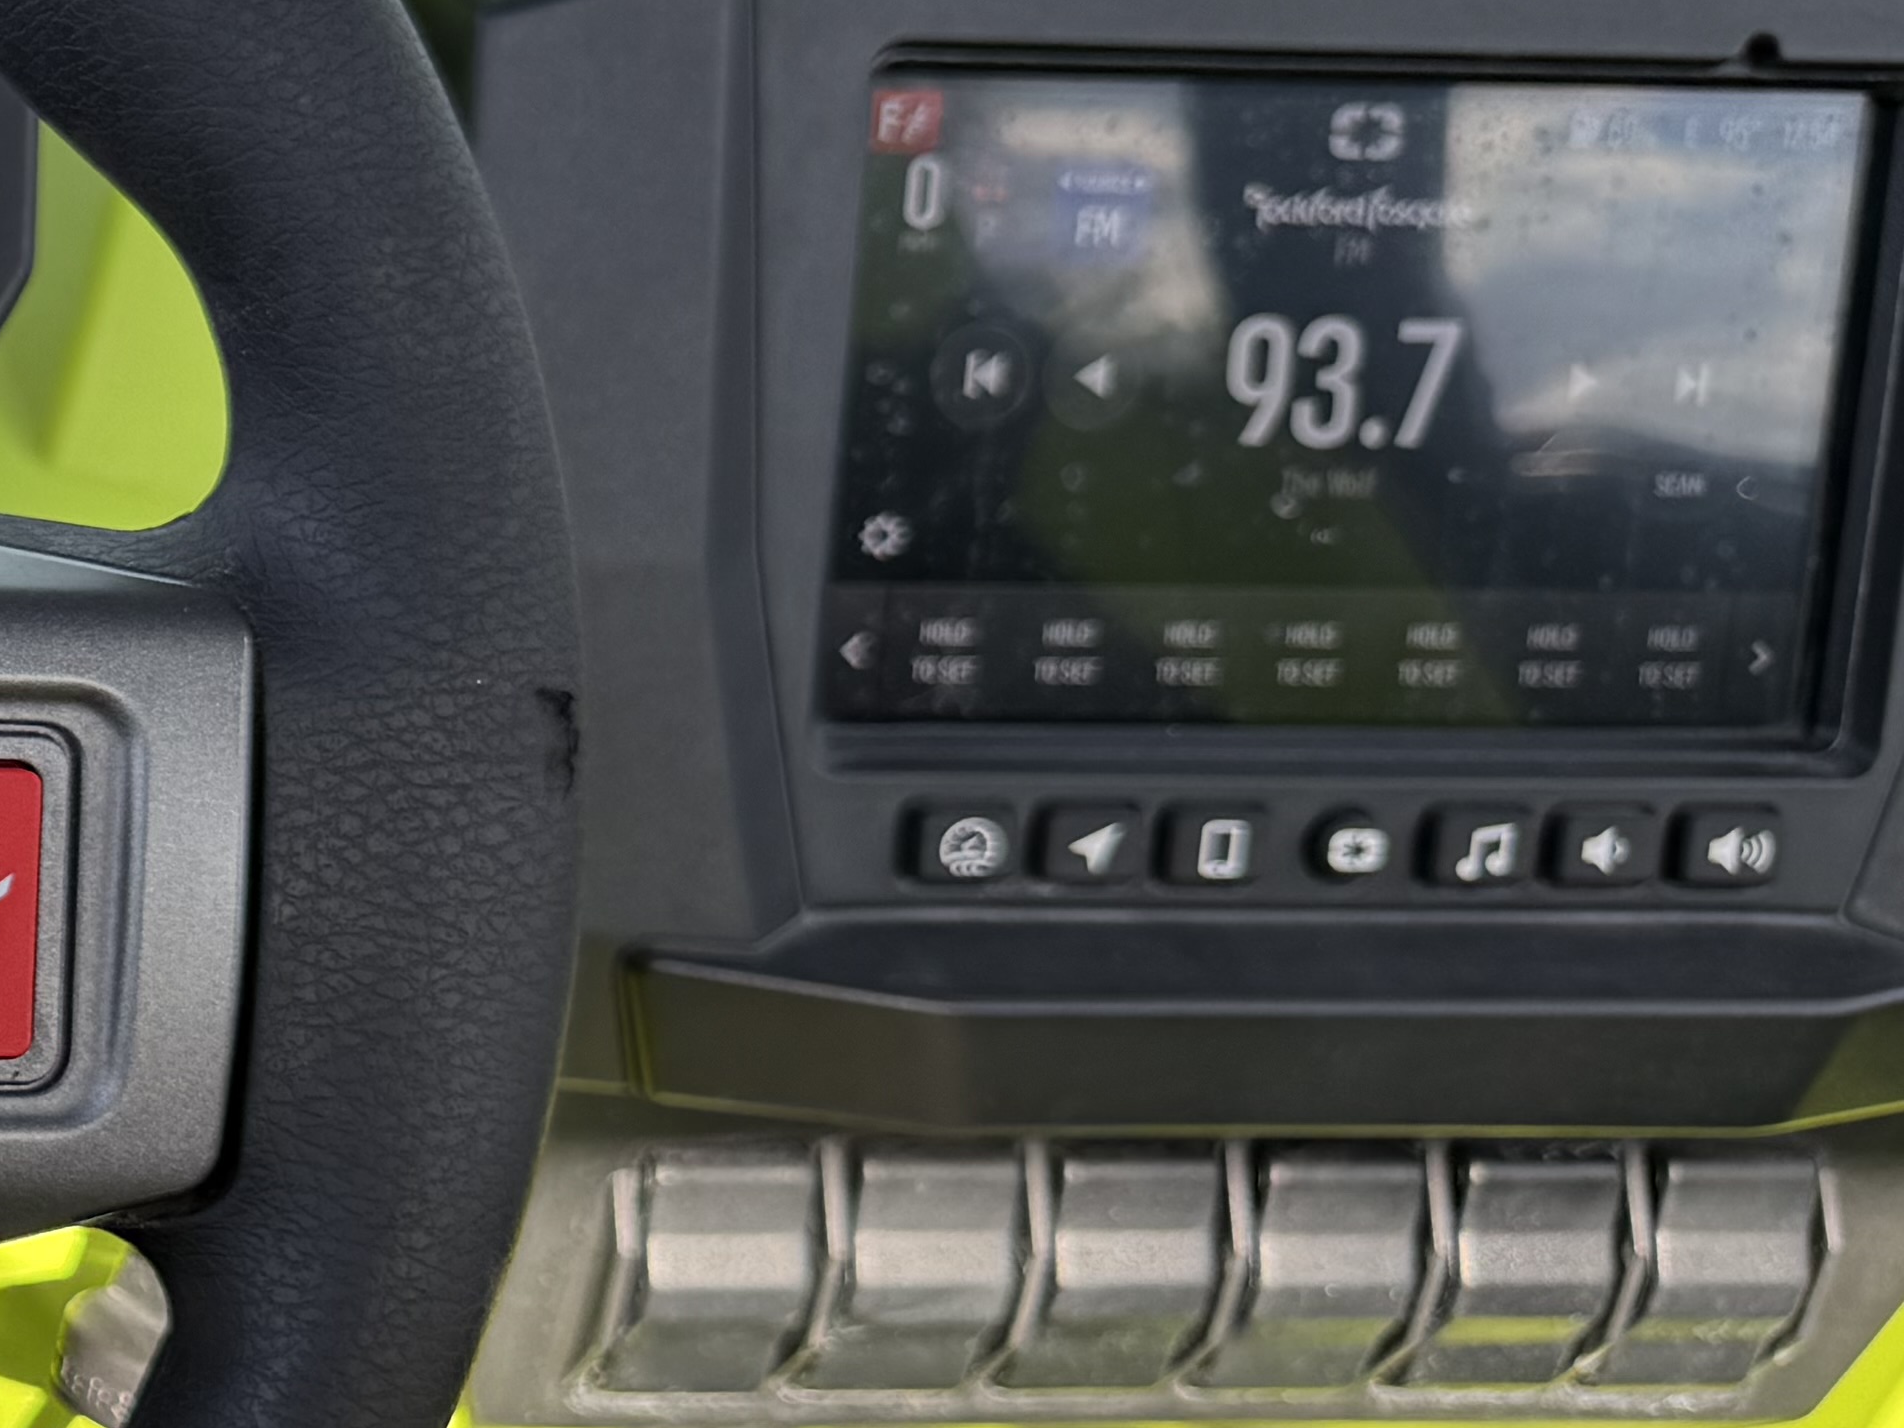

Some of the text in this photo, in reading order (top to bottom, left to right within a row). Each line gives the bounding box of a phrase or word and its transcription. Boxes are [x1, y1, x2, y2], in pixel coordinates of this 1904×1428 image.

[903, 154, 945, 232] 0
[1073, 205, 1126, 249] FM
[1226, 312, 1465, 450] 93.7
